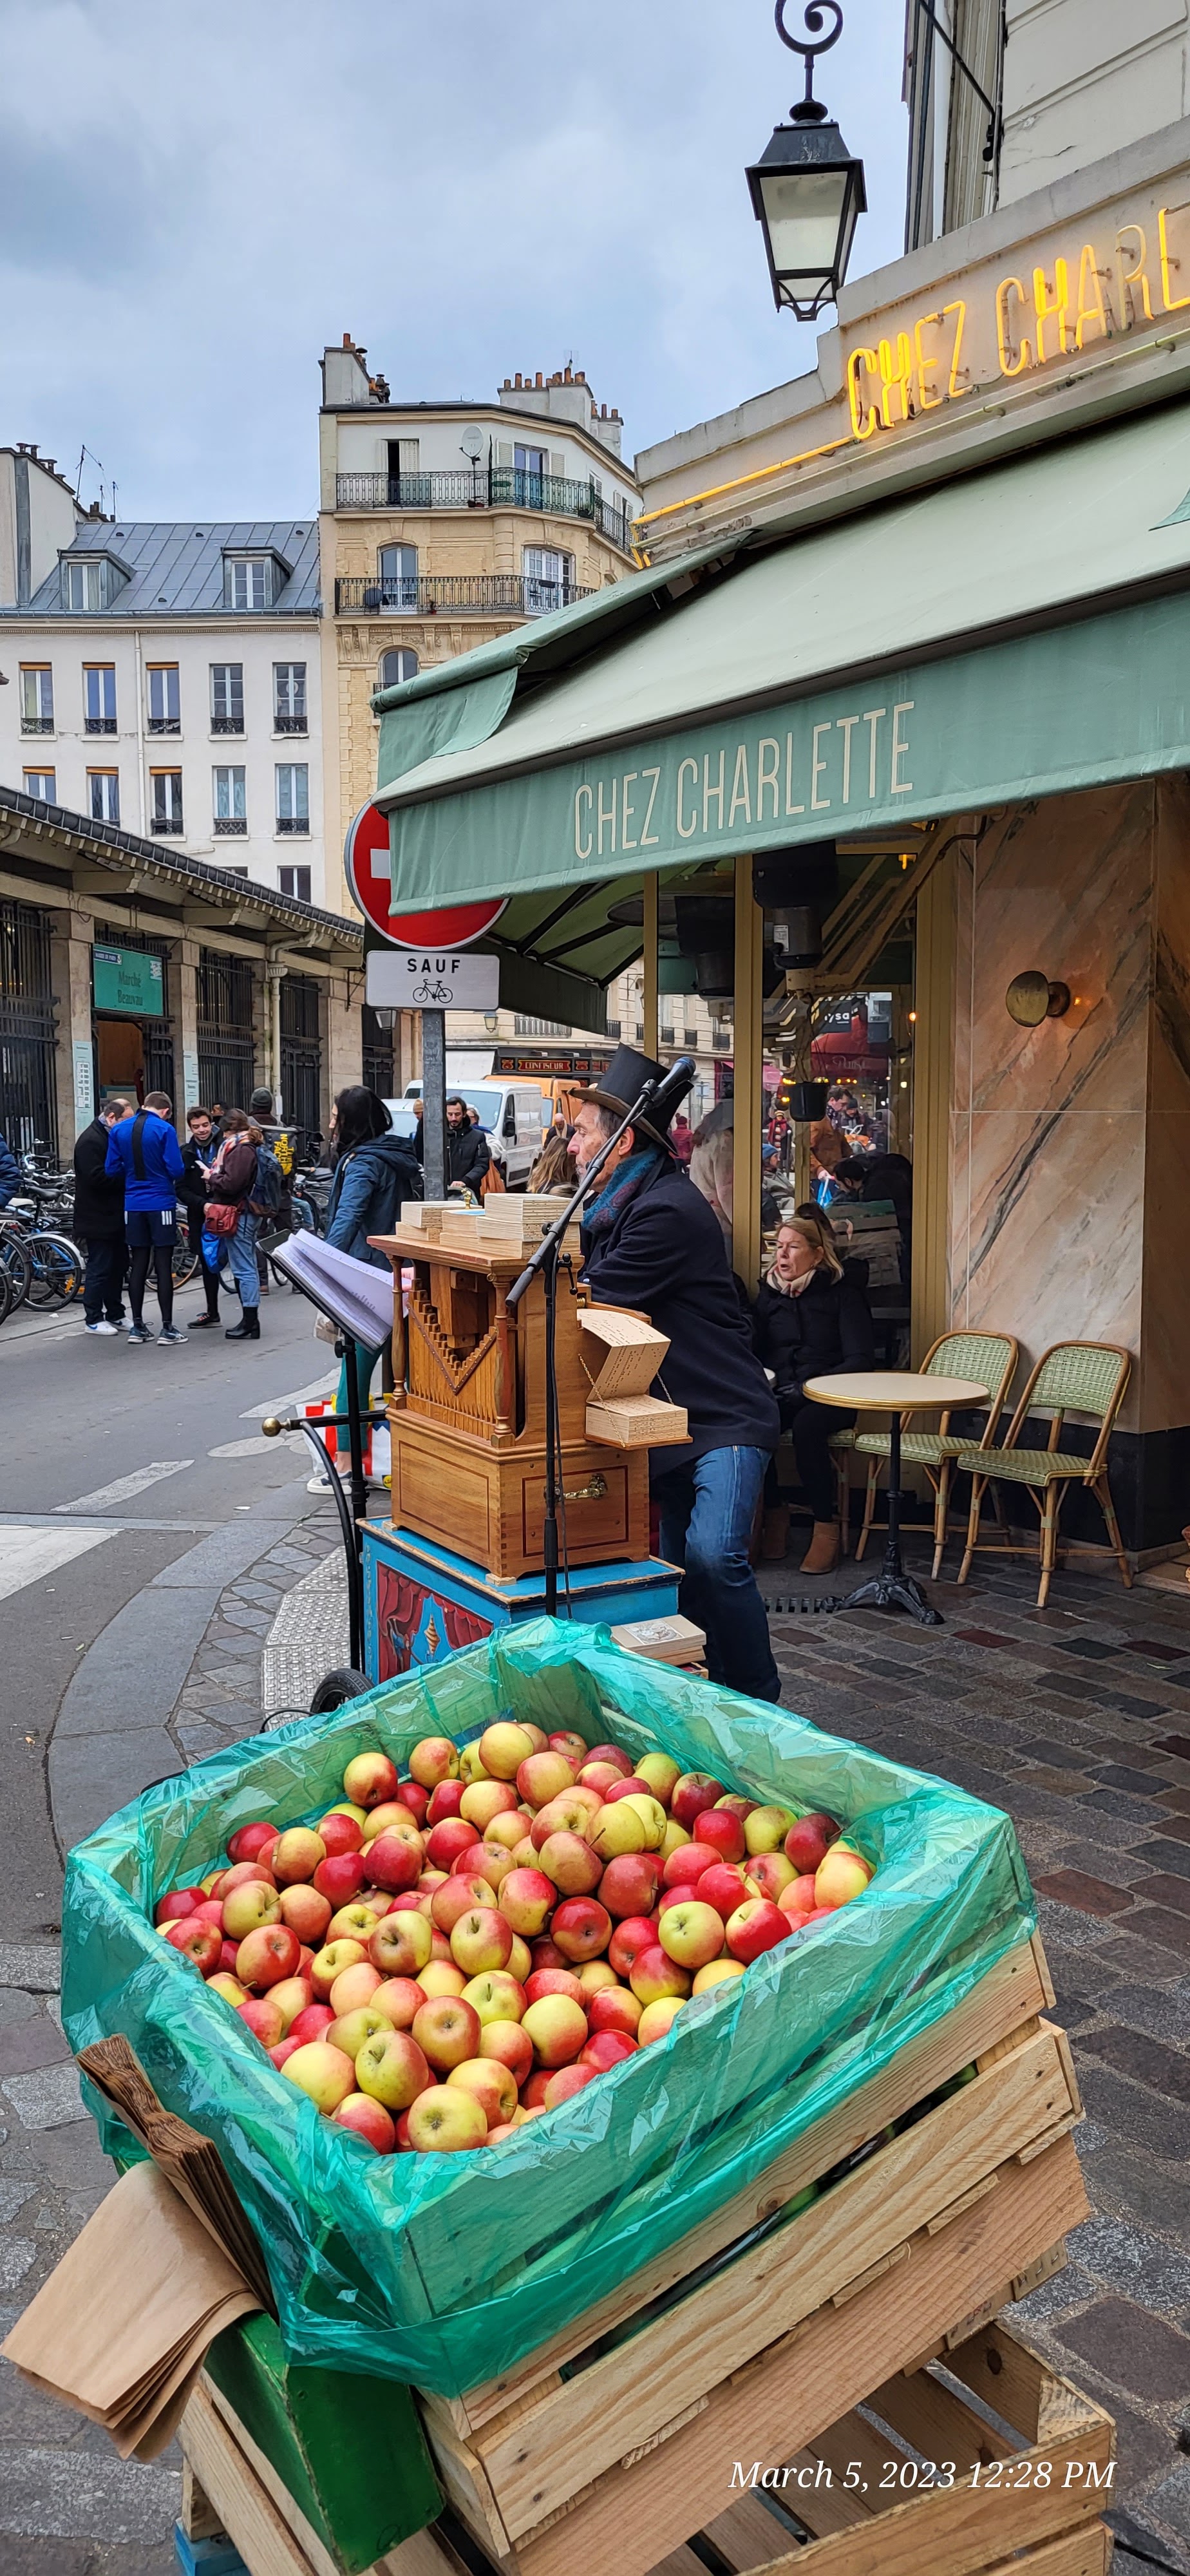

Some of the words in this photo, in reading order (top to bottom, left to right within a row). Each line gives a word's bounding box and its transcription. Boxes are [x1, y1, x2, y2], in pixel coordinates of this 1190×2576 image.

[847, 300, 975, 439] CHEZ
[575, 767, 661, 859] CHEZ
[677, 701, 914, 838] CHARLETTE
[118, 971, 141, 987] Marché
[407, 958, 460, 973] SAUF
[279, 1133, 288, 1163] NORTH
